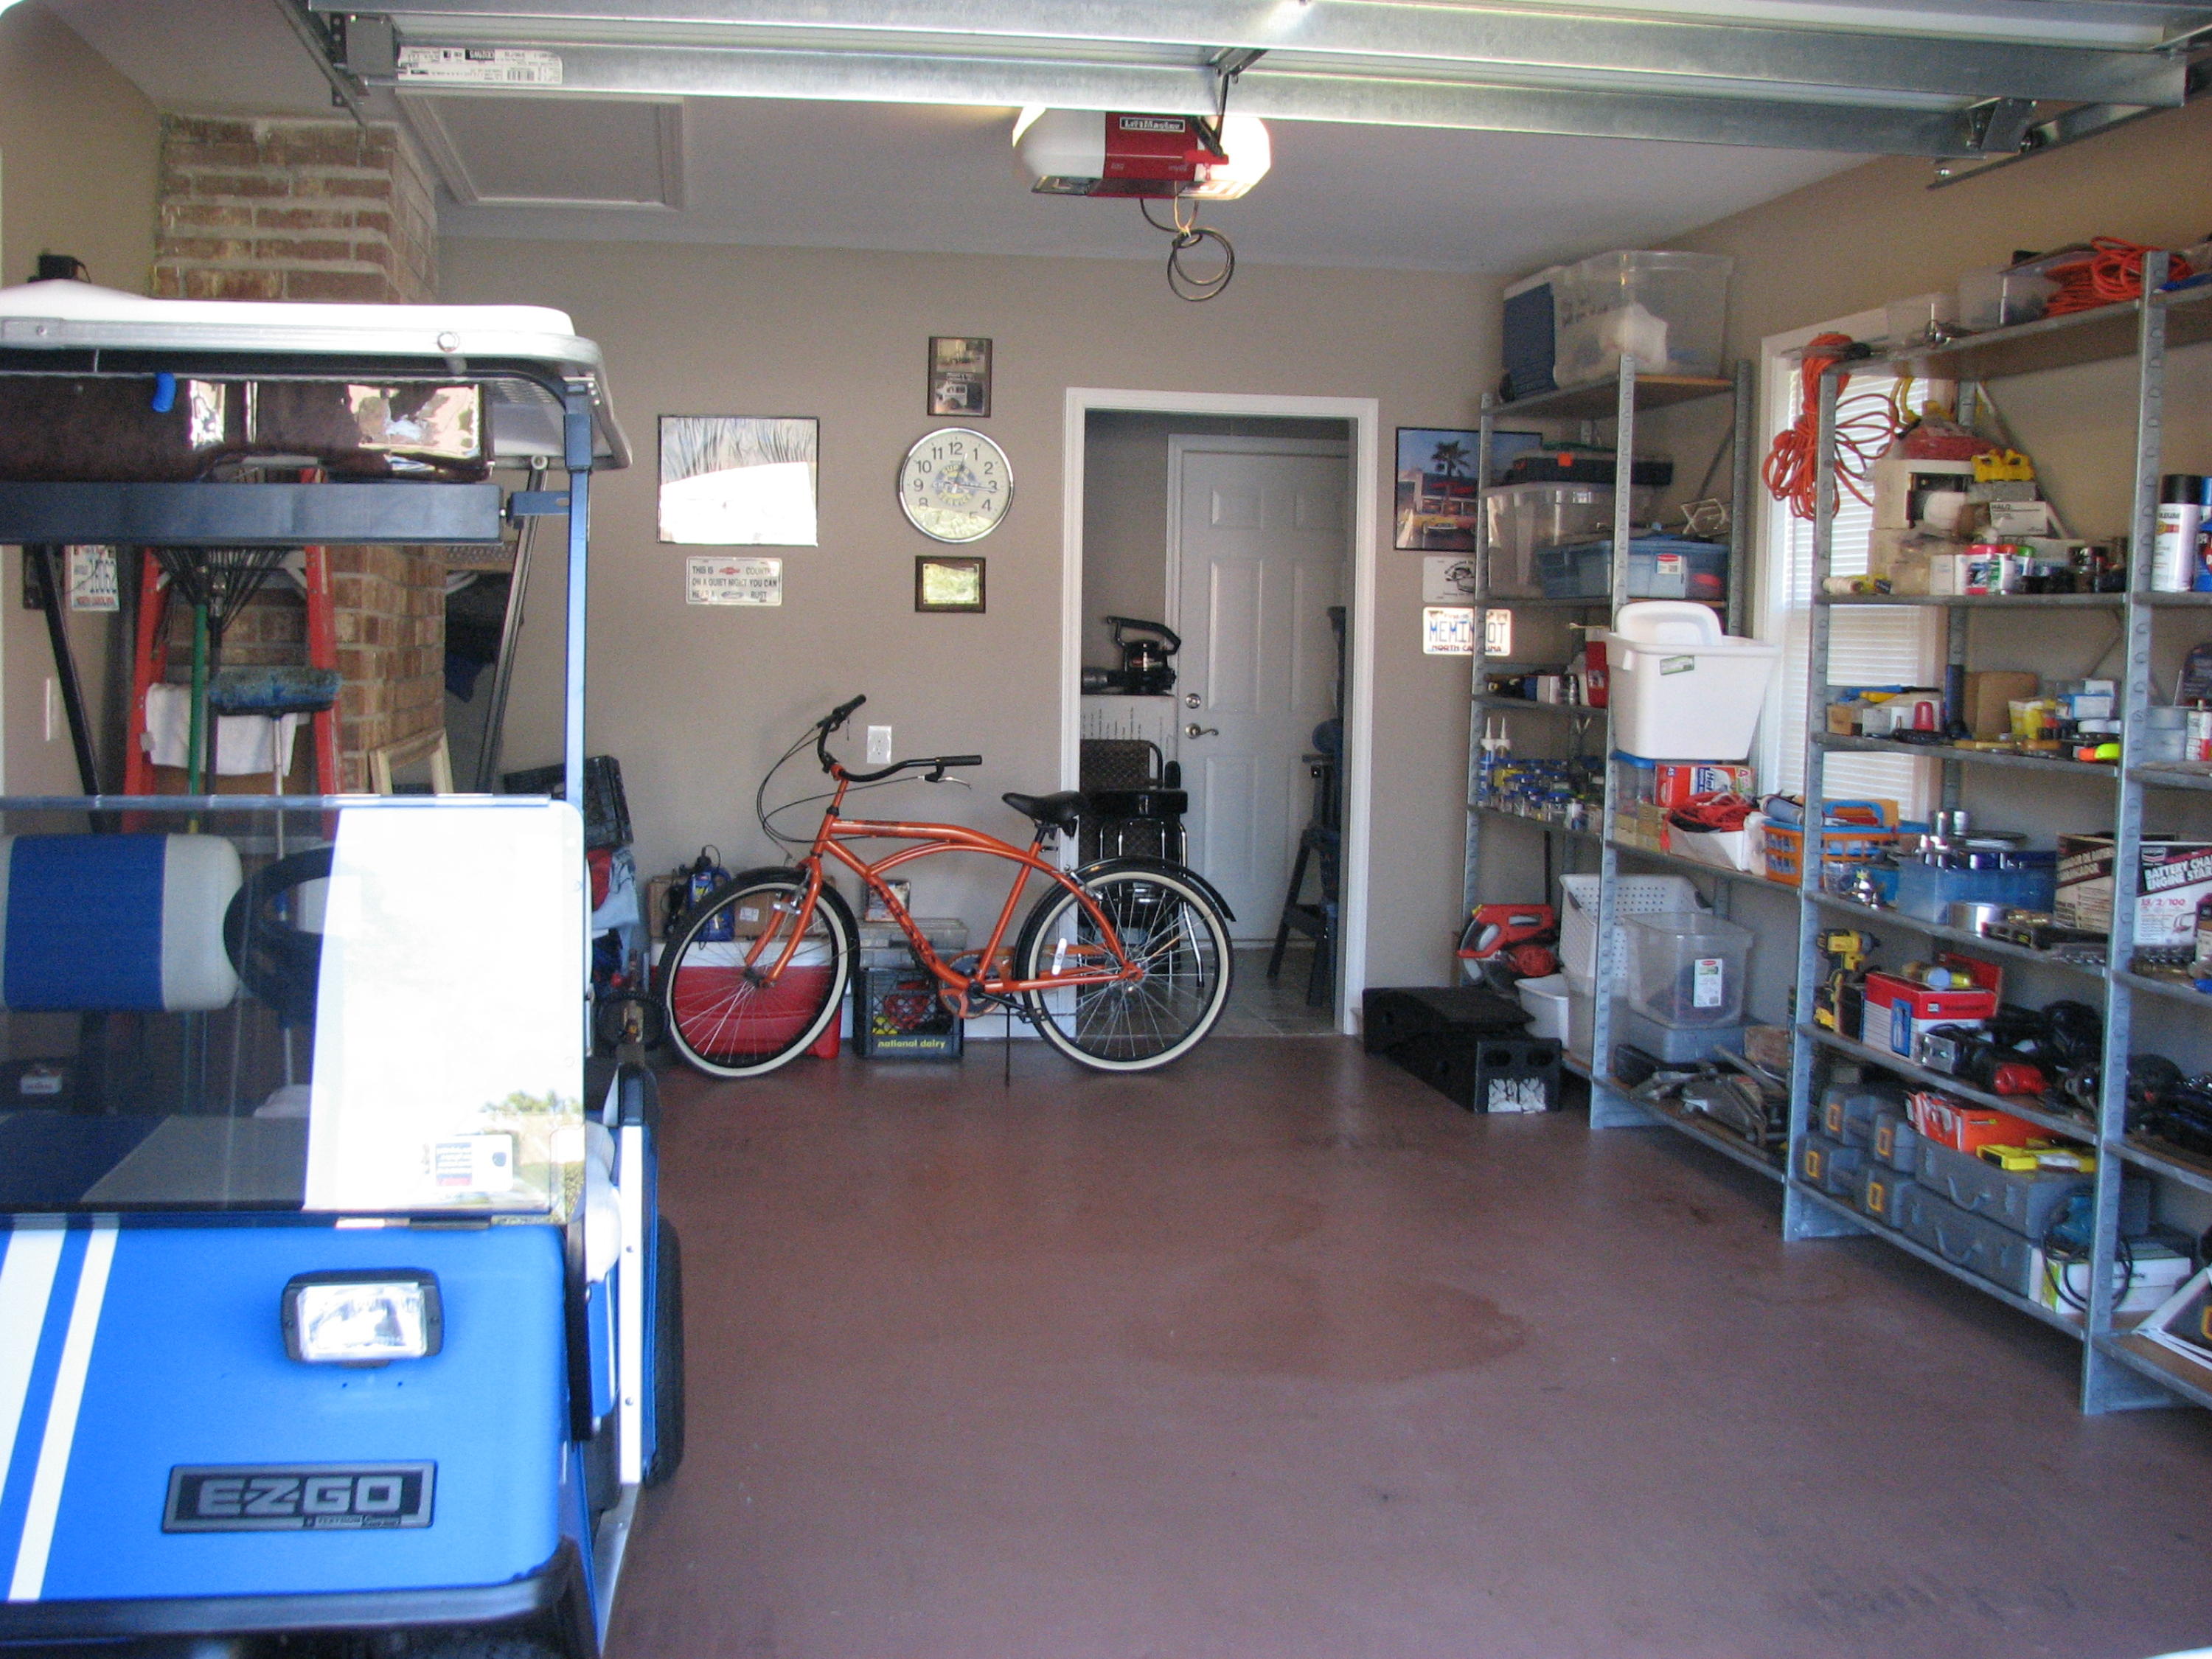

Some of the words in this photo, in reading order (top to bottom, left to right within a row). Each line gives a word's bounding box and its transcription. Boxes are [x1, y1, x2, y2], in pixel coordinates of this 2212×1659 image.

[1124, 119, 1180, 130] LiftMaster
[933, 447, 943, 460] 11
[949, 442, 963, 455] 12
[974, 448, 978, 461] 1
[917, 460, 932, 473] 10
[984, 462, 993, 475] 2
[914, 479, 924, 492] 9
[989, 481, 998, 493] 3
[919, 498, 929, 510] 8
[982, 499, 991, 512] 4
[692, 566, 706, 574] THIS
[708, 566, 714, 574] IS
[745, 567, 774, 575] COUNTR
[708, 578, 727, 587] QUIET
[749, 579, 762, 587] YOU
[764, 579, 777, 588] CAN
[2144, 860, 2188, 879] BATTERY
[2191, 855, 2212, 870] CHA
[2146, 872, 2185, 891] ENGINE
[877, 1039, 918, 1048] national
[919, 1039, 945, 1049] dairy
[197, 1477, 403, 1516] EZGO
